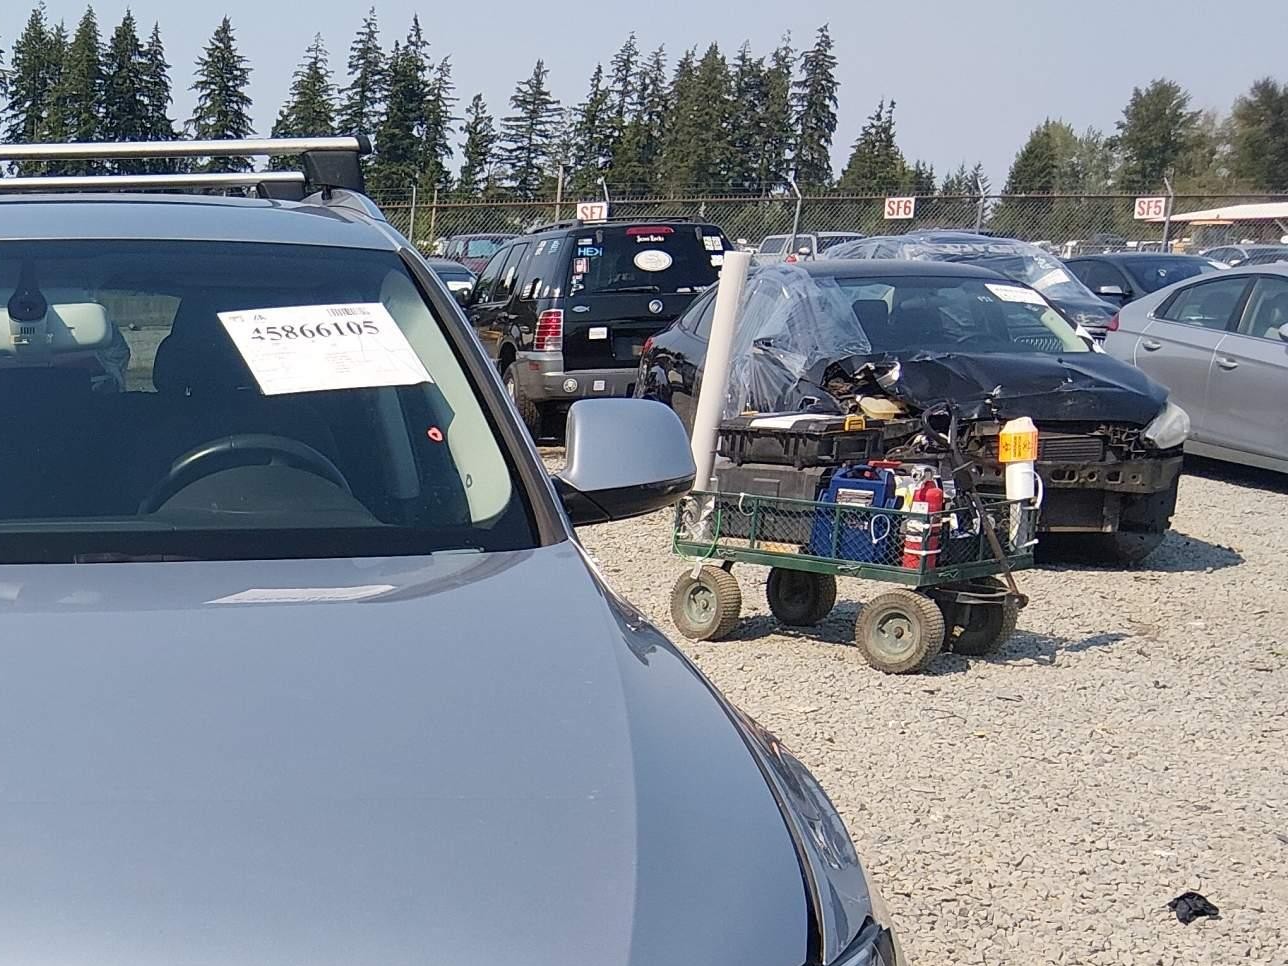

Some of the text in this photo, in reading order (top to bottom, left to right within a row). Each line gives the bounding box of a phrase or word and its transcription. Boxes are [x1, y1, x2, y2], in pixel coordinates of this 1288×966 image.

[581, 206, 603, 219] SF7
[887, 200, 912, 216] SF6
[1137, 200, 1162, 216] SF5
[251, 320, 381, 341] 45866105
